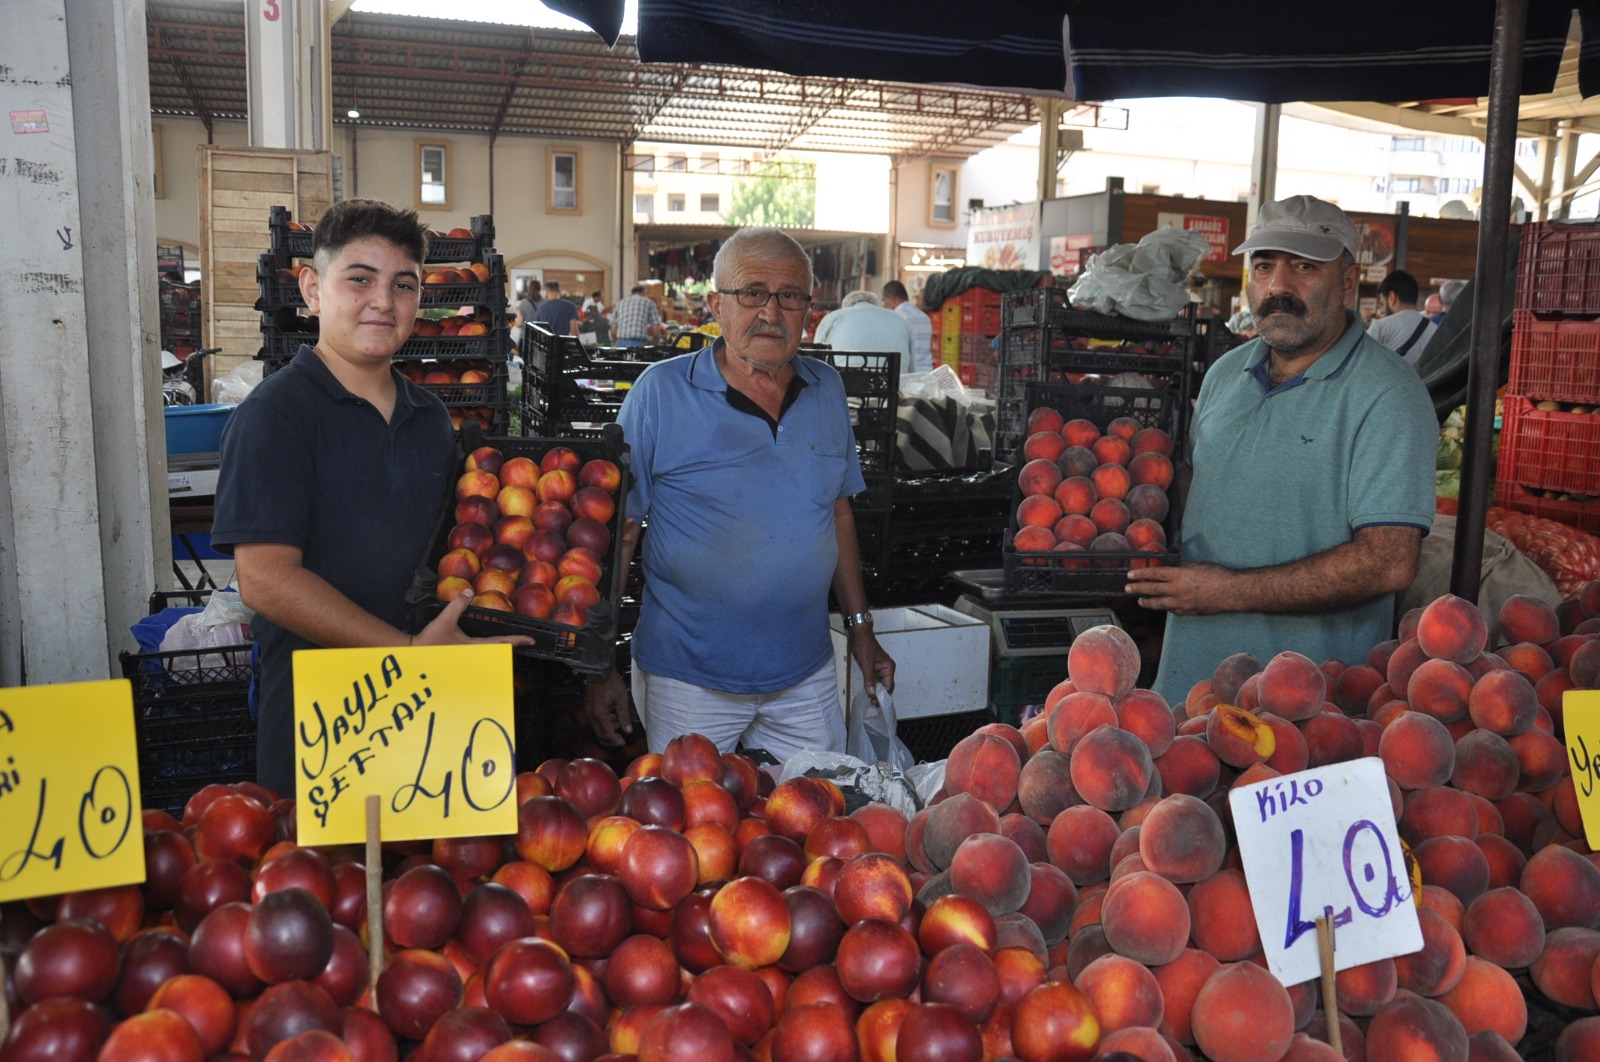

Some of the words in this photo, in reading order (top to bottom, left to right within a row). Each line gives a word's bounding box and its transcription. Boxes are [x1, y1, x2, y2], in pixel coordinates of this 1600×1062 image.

[264, 0, 279, 21] 3
[300, 654, 402, 780] YAYLA
[392, 711, 517, 819] 40
[0, 766, 131, 881] 40
